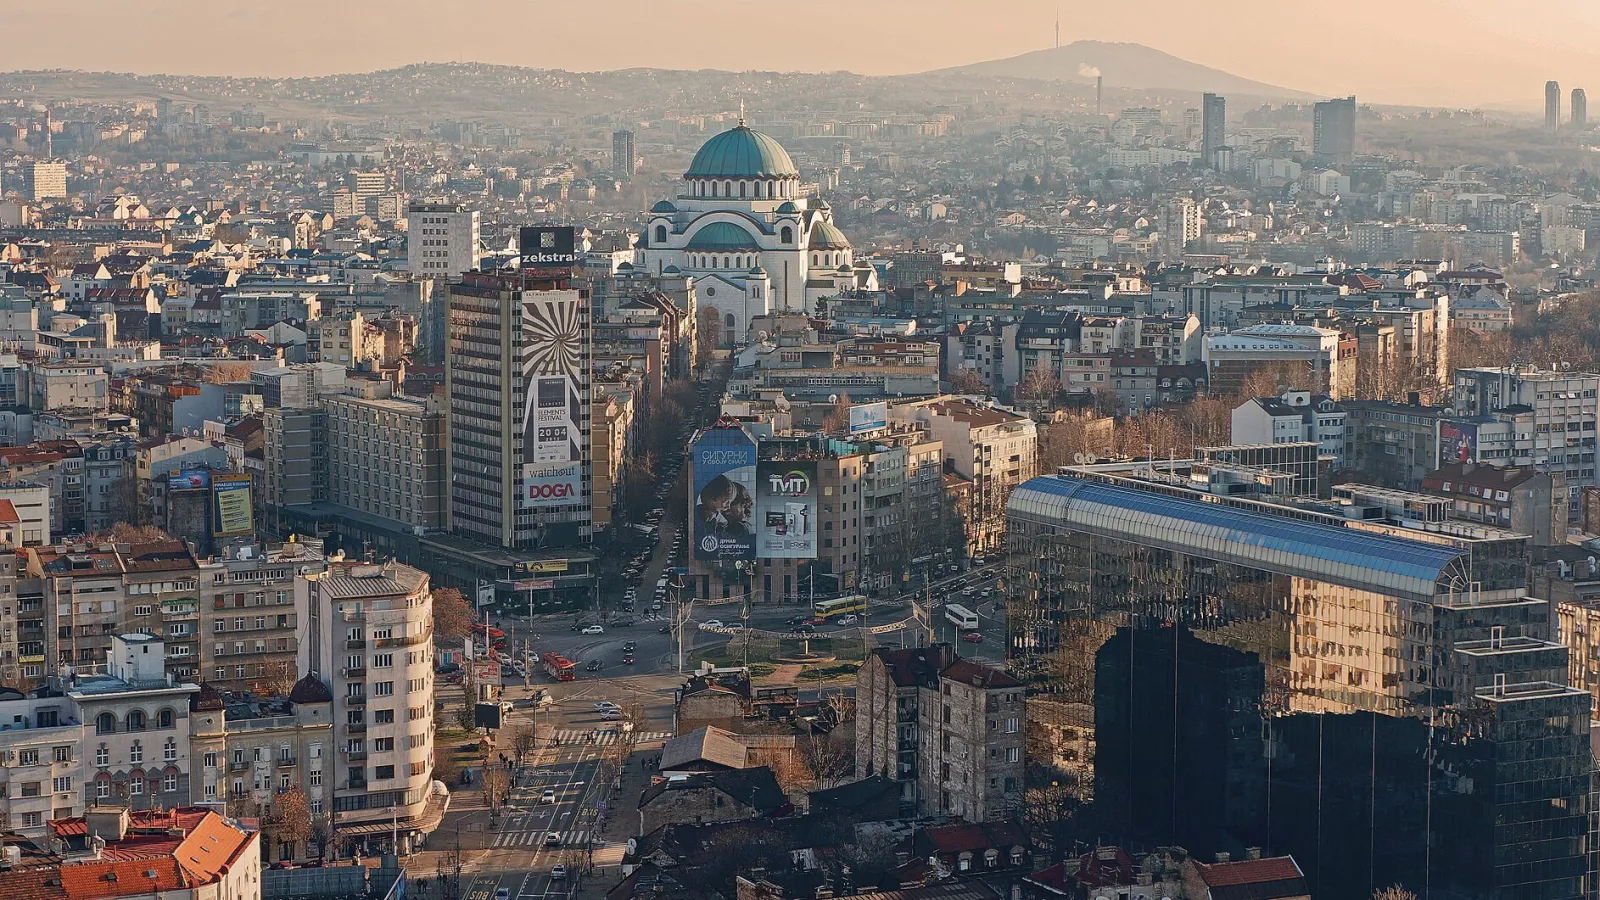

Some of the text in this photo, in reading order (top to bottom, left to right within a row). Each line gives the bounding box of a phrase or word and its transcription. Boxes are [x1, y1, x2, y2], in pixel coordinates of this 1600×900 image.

[522, 252, 573, 263] zekstra
[539, 428, 567, 437] 20 04
[702, 450, 748, 460] СИГУРНИ
[529, 466, 575, 478] watchout
[529, 483, 575, 499] DOGA
[470, 891, 489, 900] BUS
